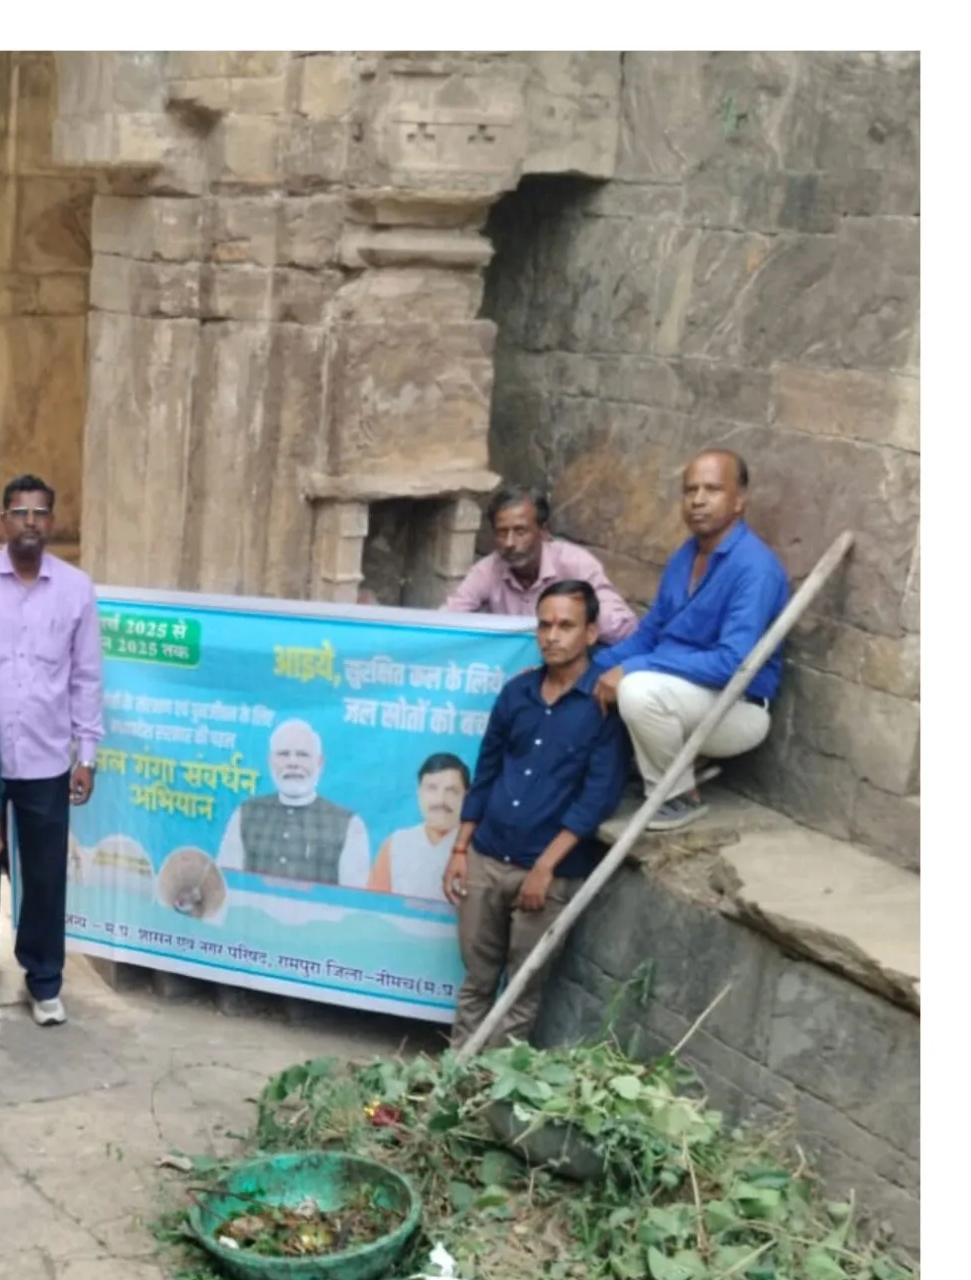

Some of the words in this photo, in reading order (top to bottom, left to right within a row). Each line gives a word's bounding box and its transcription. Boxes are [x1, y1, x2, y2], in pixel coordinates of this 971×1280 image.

[125, 619, 168, 639] 2025
[179, 751, 261, 796] संवर्धन
[129, 780, 215, 821] अभियान
[278, 955, 321, 978] रामपुरा
